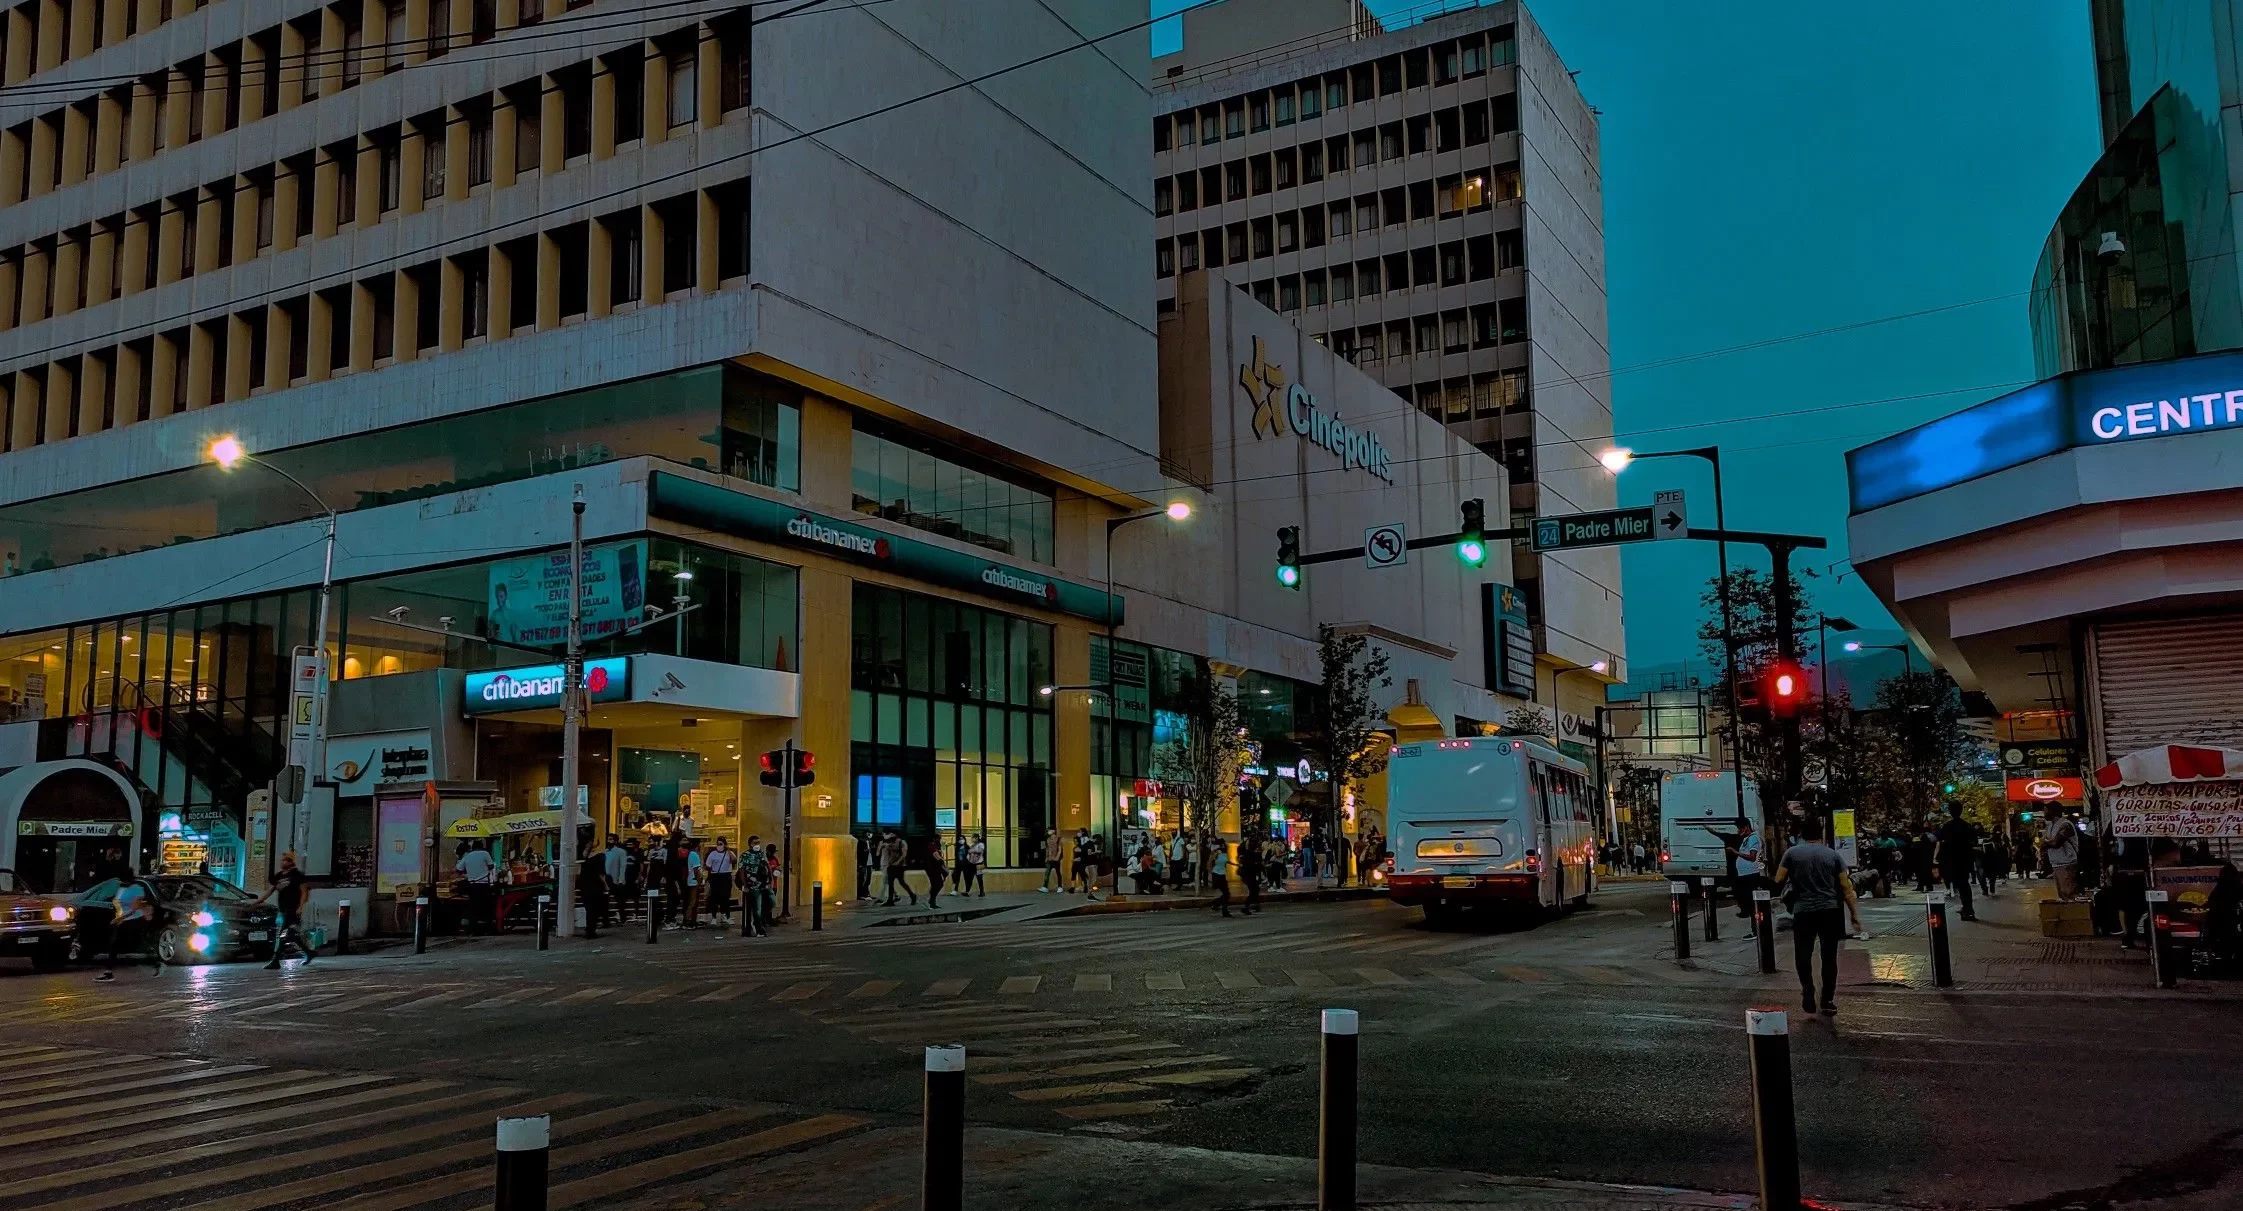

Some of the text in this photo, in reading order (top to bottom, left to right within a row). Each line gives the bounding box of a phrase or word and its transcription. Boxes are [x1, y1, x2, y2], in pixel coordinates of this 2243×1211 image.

[2091, 389, 2243, 439] CENTR
[1287, 383, 1392, 482] Cinépolis
[1656, 491, 1683, 502] PTE.
[786, 518, 877, 555] citibanamex
[1540, 516, 1649, 545] 24 Padre Mier
[981, 568, 1047, 598] citibanamex
[482, 673, 588, 701] citibanamx
[2115, 799, 2181, 811] GORDITAS
[506, 817, 548, 831] Tostitos
[2115, 824, 2141, 834] DOGS
[2156, 822, 2176, 833] 40
[2116, 814, 2137, 823] HOT
[51, 825, 83, 834] Padre
